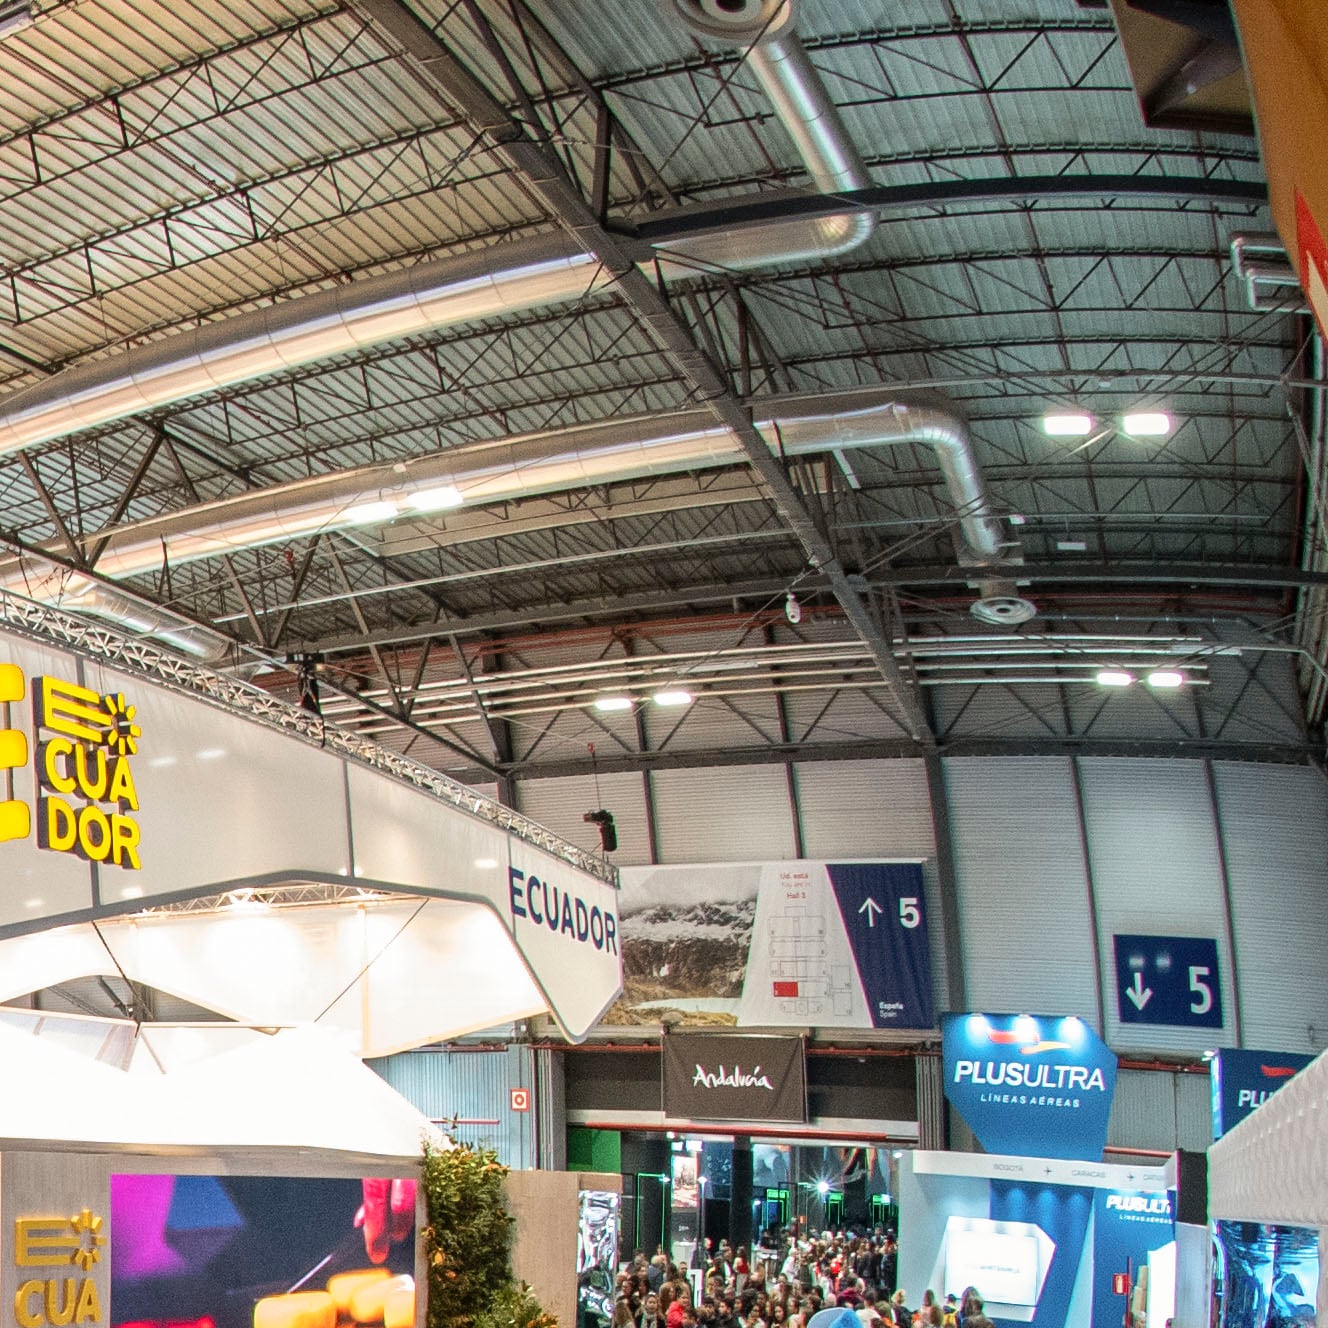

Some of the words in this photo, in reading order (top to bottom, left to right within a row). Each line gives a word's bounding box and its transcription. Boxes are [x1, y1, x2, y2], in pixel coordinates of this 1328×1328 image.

[36, 736, 140, 811] CUA
[36, 795, 142, 870] DOR
[508, 866, 618, 957] ECUADOR
[899, 897, 921, 928] 5
[1188, 965, 1215, 1014] 5
[692, 1064, 774, 1090] Andalucía
[954, 1060, 1106, 1091] PLUSULTRA
[981, 1092, 1027, 1105] LÍNEAS
[1029, 1095, 1081, 1108] AÉREAS
[16, 1279, 100, 1328] CUA
